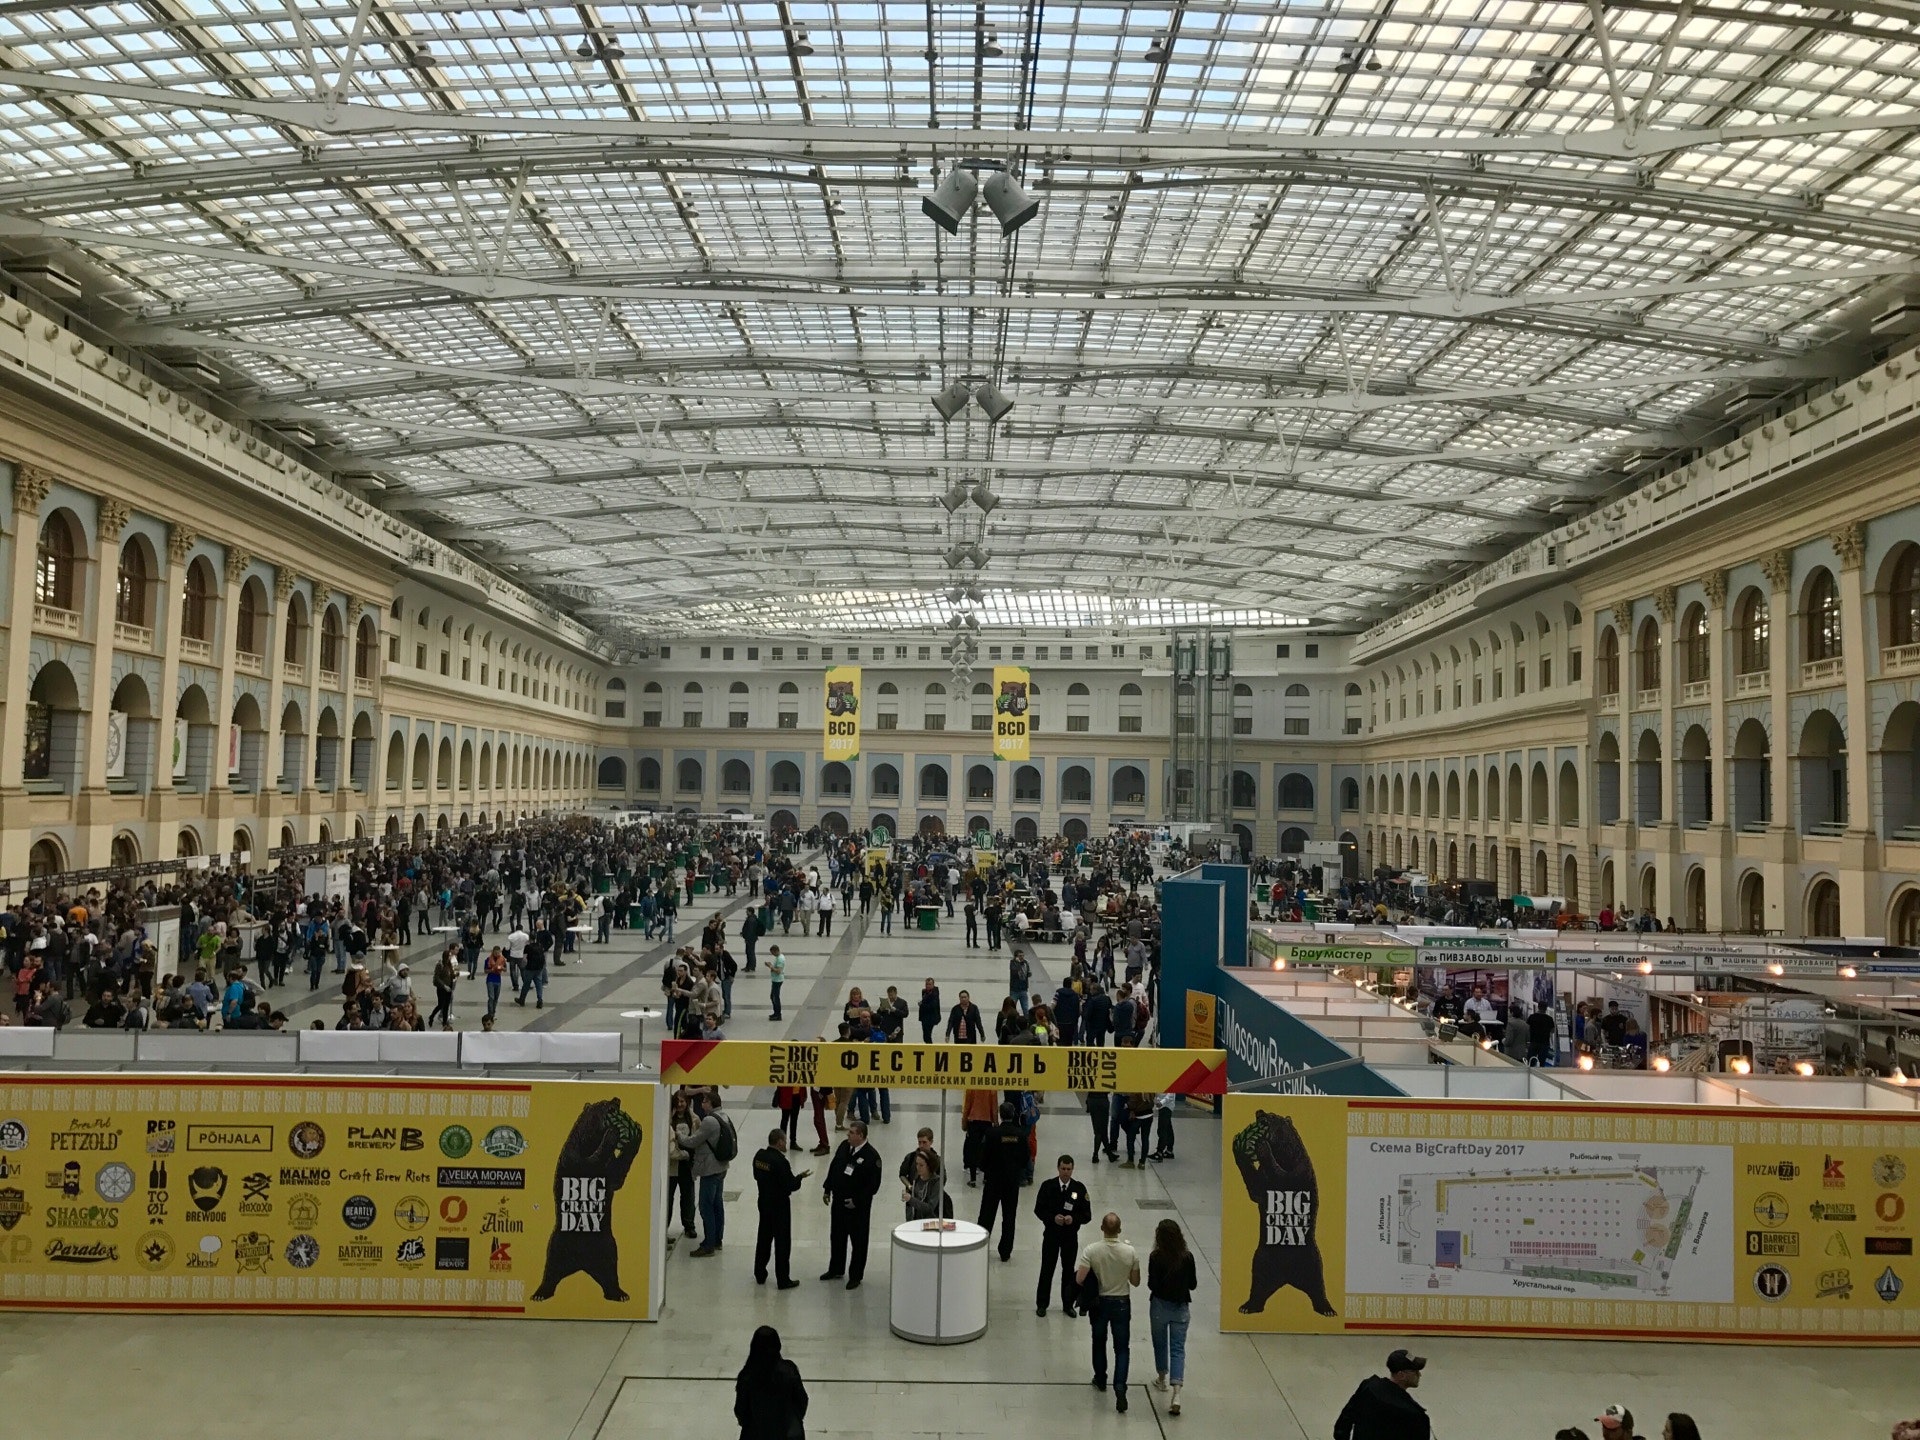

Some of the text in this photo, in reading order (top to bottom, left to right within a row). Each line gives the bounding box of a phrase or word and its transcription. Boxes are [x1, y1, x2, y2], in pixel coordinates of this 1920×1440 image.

[828, 722, 856, 736] BCD
[998, 722, 1026, 736] BCD
[829, 738, 854, 750] 2017
[1000, 738, 1024, 750] 2017
[1291, 946, 1372, 962] Браумастер
[1440, 953, 1502, 964] ПИВЗАВОДЫ
[1516, 956, 1544, 964] ЧЕХИИ
[1604, 954, 1625, 963] draft
[1722, 958, 1758, 966] МАШИНЫ
[1772, 958, 1834, 966] ОБОРУДОВАНИЕ
[787, 1046, 818, 1062] BIG
[1068, 1051, 1099, 1068] BIG
[769, 1045, 786, 1084] 2017
[787, 1062, 818, 1071] CRAFT
[840, 1050, 1047, 1074] ФЕСТИВАЛЬ
[1068, 1068, 1098, 1076] CRAFT
[1102, 1051, 1117, 1090] 2017
[787, 1071, 817, 1084] DAY
[857, 1074, 1030, 1086] МАЛЫХ РОССИЙСКИХ ПИВОВАРЕН
[1068, 1076, 1098, 1089] DAY
[147, 1120, 176, 1134] RED
[348, 1127, 396, 1140] PLAN
[50, 1132, 118, 1150] PETZOLD
[199, 1131, 261, 1144] PÕHJALA
[348, 1142, 396, 1150] BREWERY
[1370, 1142, 1525, 1157] Схема BigCraftDay 2017
[1570, 1152, 1600, 1161] Рыбный
[339, 1168, 430, 1182] Craft Brew Riots
[481, 1171, 522, 1180] MORAVA
[562, 1176, 606, 1201] BIG
[148, 1191, 169, 1202] TO
[1266, 1190, 1310, 1214] BIG
[345, 1206, 373, 1217] HEARTLY
[561, 1201, 605, 1212] CRAFT
[186, 1211, 226, 1222] BREWDOG
[480, 1212, 524, 1234] Anton
[561, 1212, 604, 1232] DAY
[1266, 1214, 1310, 1226] CRAFT
[1266, 1227, 1309, 1246] DAY
[1750, 1233, 1797, 1253] 8 BARRELS
[45, 1238, 118, 1260] Paradox
[338, 1246, 383, 1258] БАКУНИН
[1764, 1244, 1784, 1253] BREW
[1512, 1279, 1562, 1291] Хрустальный
